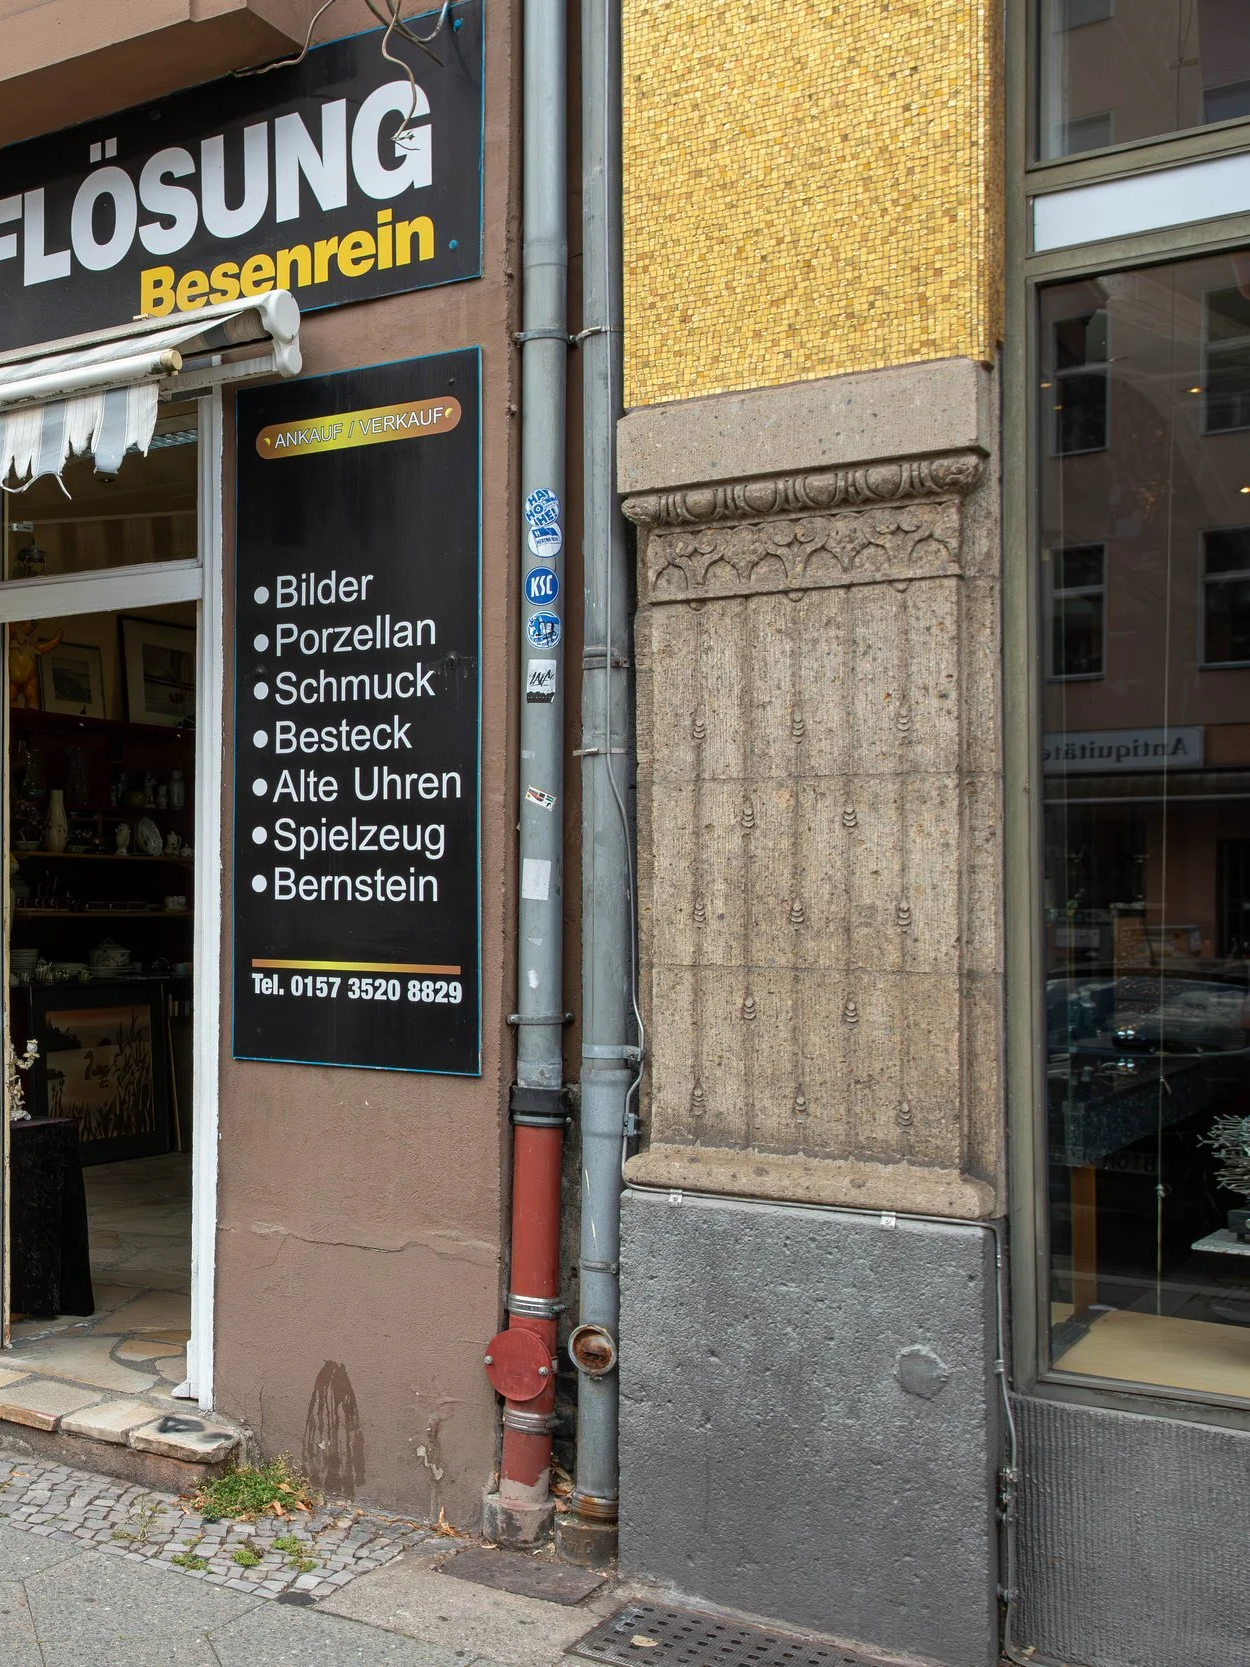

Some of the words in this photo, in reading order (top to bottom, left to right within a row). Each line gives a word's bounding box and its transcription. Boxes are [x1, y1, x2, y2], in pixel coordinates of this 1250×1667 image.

[140, 208, 435, 317] Besenrein
[274, 422, 344, 449] ANKAUF
[359, 406, 444, 435] VERKAUF
[276, 569, 374, 609] Bilder
[530, 574, 553, 597] KSC
[276, 614, 436, 657] Porzellan
[275, 662, 435, 706] Schmuck
[275, 715, 413, 754] Besteck
[273, 768, 338, 803] Alte
[354, 766, 461, 801] Uhren
[273, 817, 445, 860] Spielzeug
[274, 866, 438, 902] Bernstein
[252, 973, 285, 996] Tel.
[290, 976, 341, 999] 0157
[348, 978, 401, 1001] 3520
[407, 980, 463, 1004] 8829
